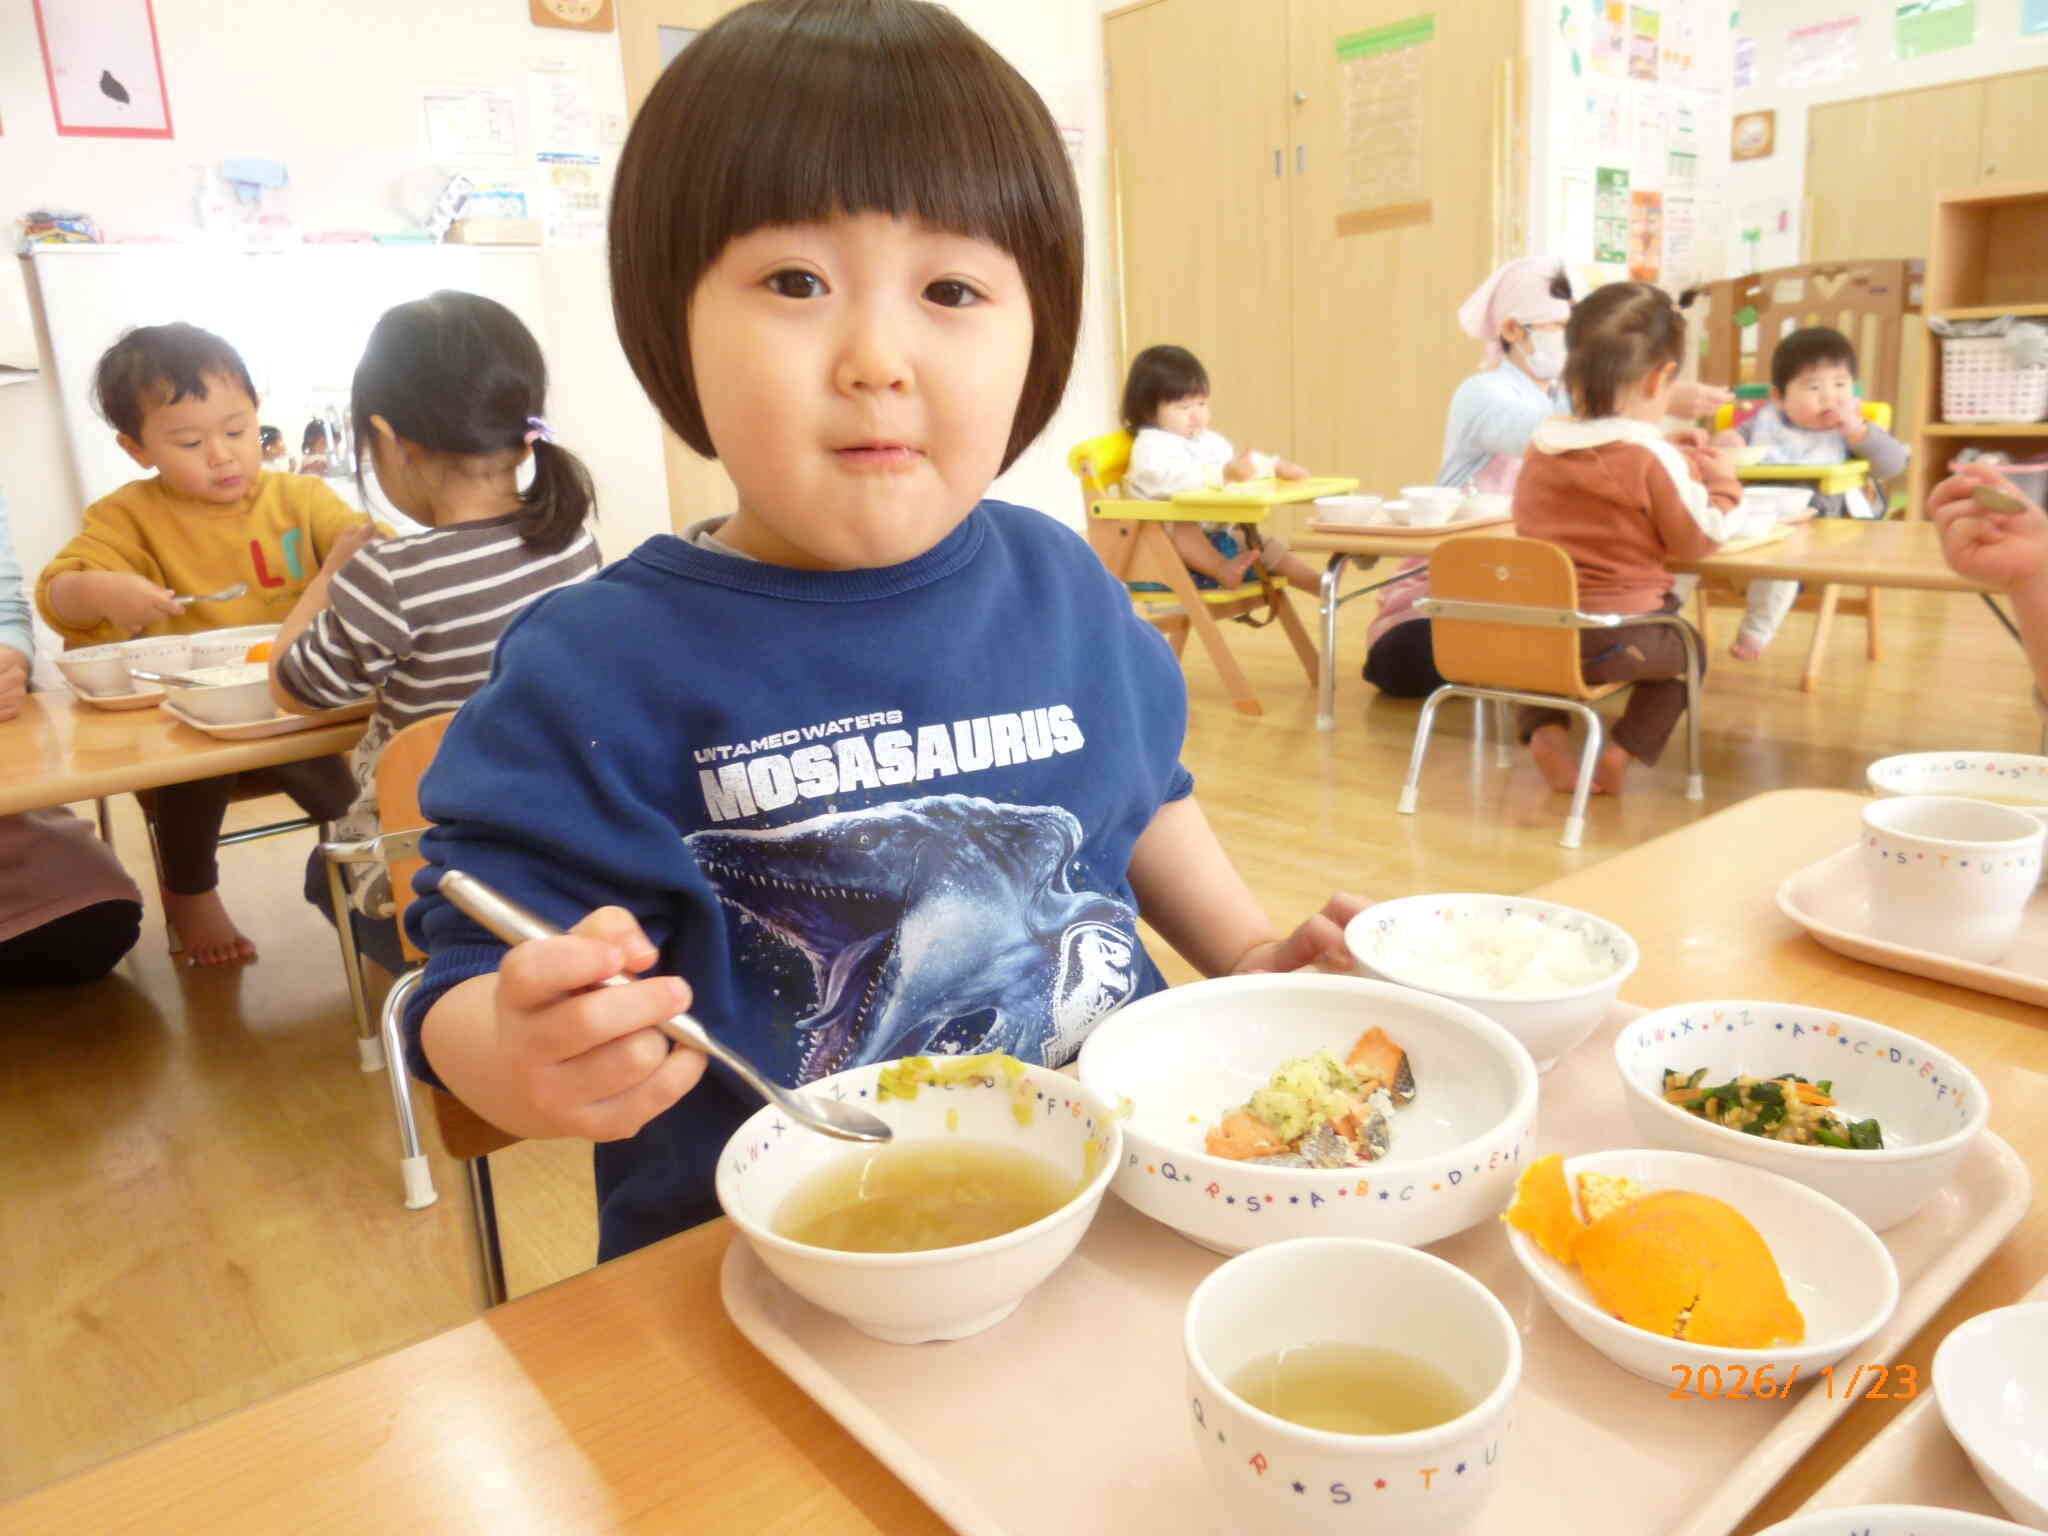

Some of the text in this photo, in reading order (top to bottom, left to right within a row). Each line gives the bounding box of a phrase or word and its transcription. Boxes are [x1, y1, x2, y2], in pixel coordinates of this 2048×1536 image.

[693, 709, 904, 763] UNTAMED WATERS
[698, 704, 1085, 823] MOSASAURUS
[1890, 1047, 1902, 1064] D
[1161, 1162, 1181, 1182] Q
[1205, 1182, 1220, 1199] R
[1247, 1196, 1261, 1212] S
[1310, 1192, 1325, 1209] A
[1355, 1180, 1369, 1197] B
[1400, 1185, 1415, 1201] C
[1448, 1170, 1462, 1185] D
[1488, 1151, 1500, 1168] E
[1193, 1397, 1498, 1505] Q R S T U
